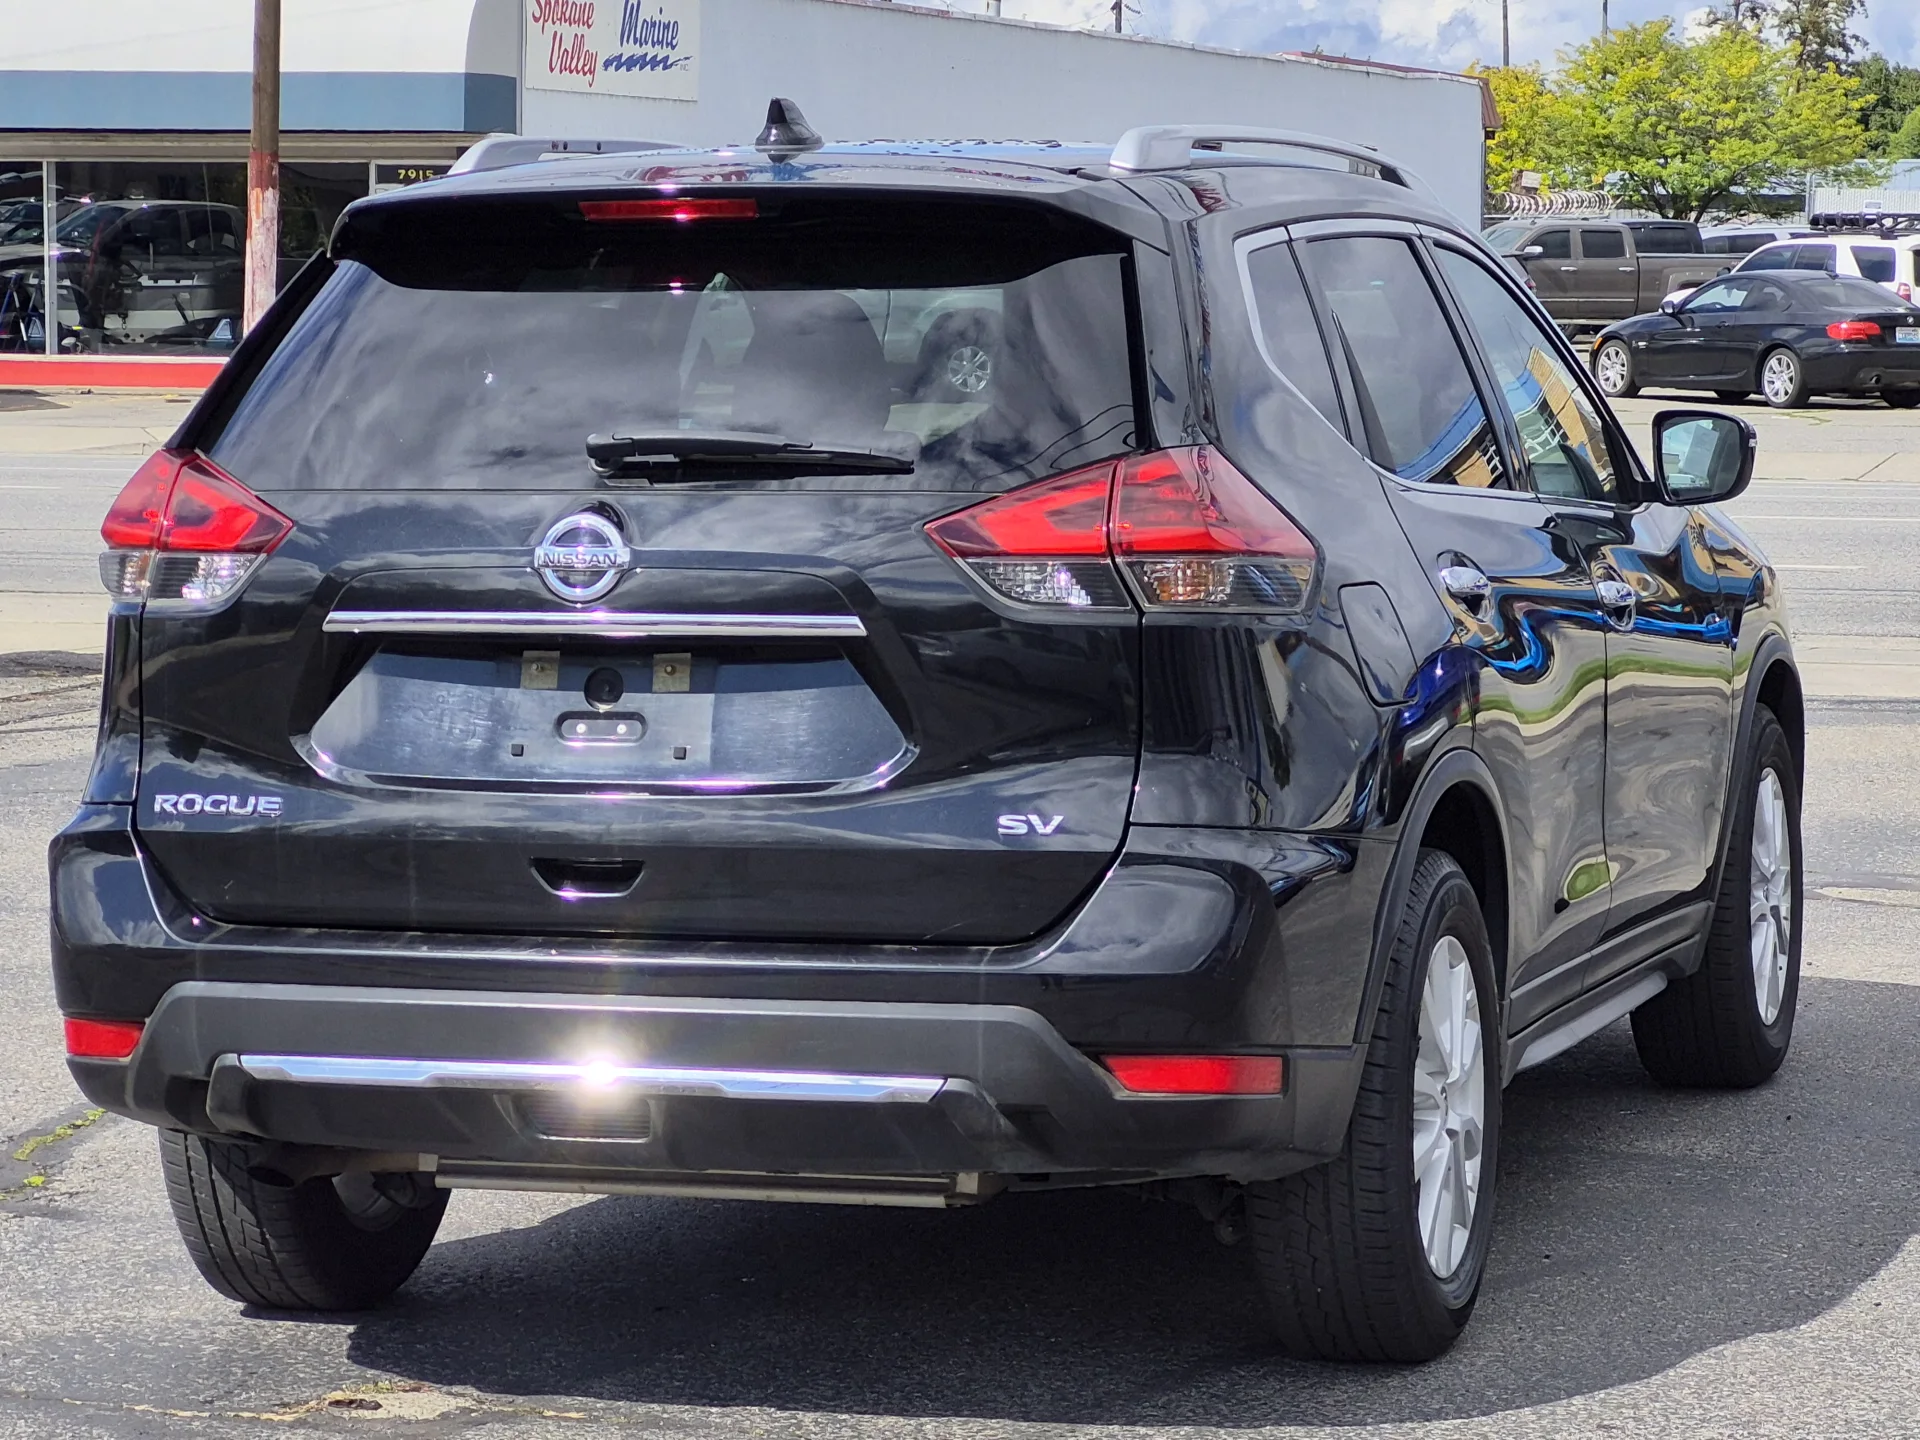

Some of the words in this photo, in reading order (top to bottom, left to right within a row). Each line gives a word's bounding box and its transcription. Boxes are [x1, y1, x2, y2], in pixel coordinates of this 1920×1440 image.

[532, 0, 595, 35] Spokane
[620, 0, 679, 50] Marine
[549, 30, 598, 88] Valley
[398, 169, 434, 182] 7915
[540, 552, 619, 566] NISSAN
[154, 793, 284, 817] ROGUE
[997, 814, 1065, 836] SV
